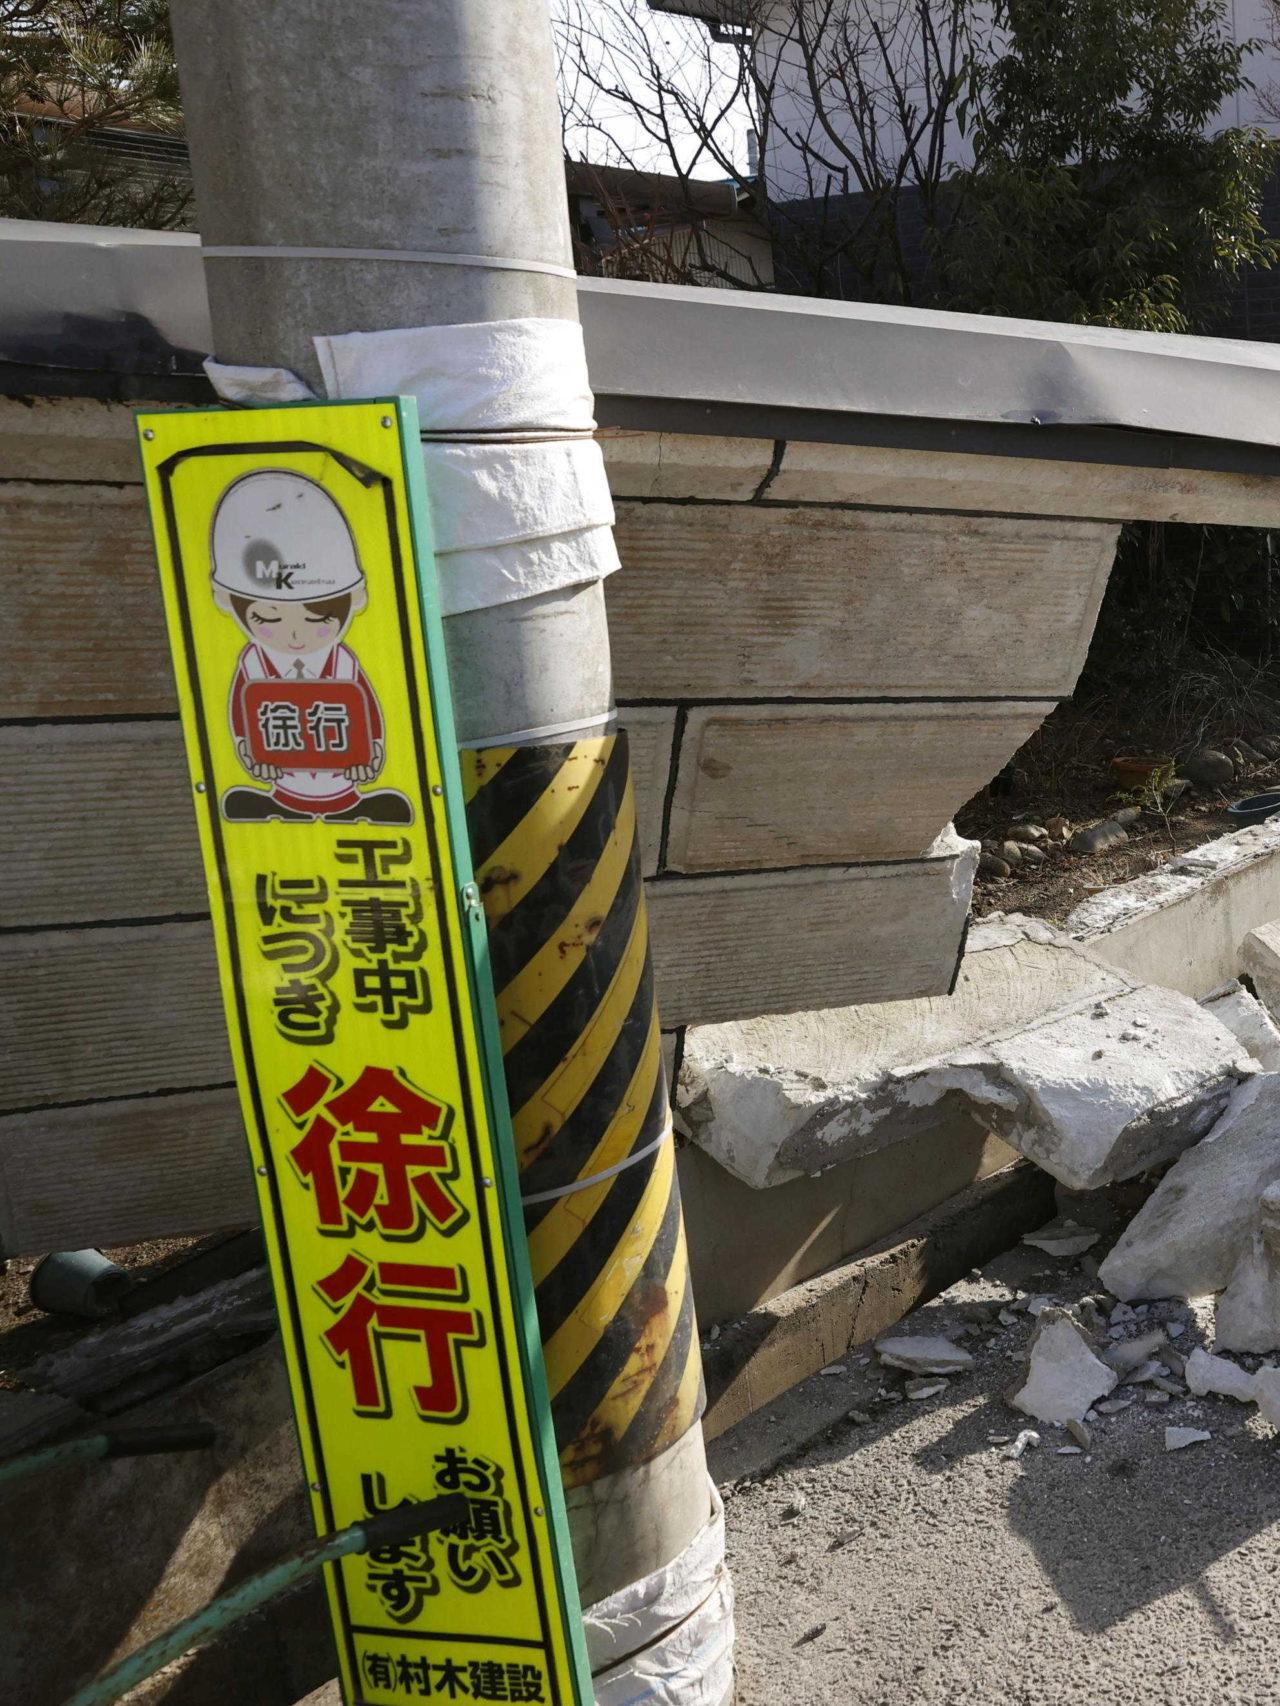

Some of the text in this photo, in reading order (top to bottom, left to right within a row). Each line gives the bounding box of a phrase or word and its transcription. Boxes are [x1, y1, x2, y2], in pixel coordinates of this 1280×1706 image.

[257, 700, 351, 753] 徐行
[255, 871, 337, 1041] につき
[335, 838, 428, 1024] 工事中
[279, 1061, 481, 1418] 徐行
